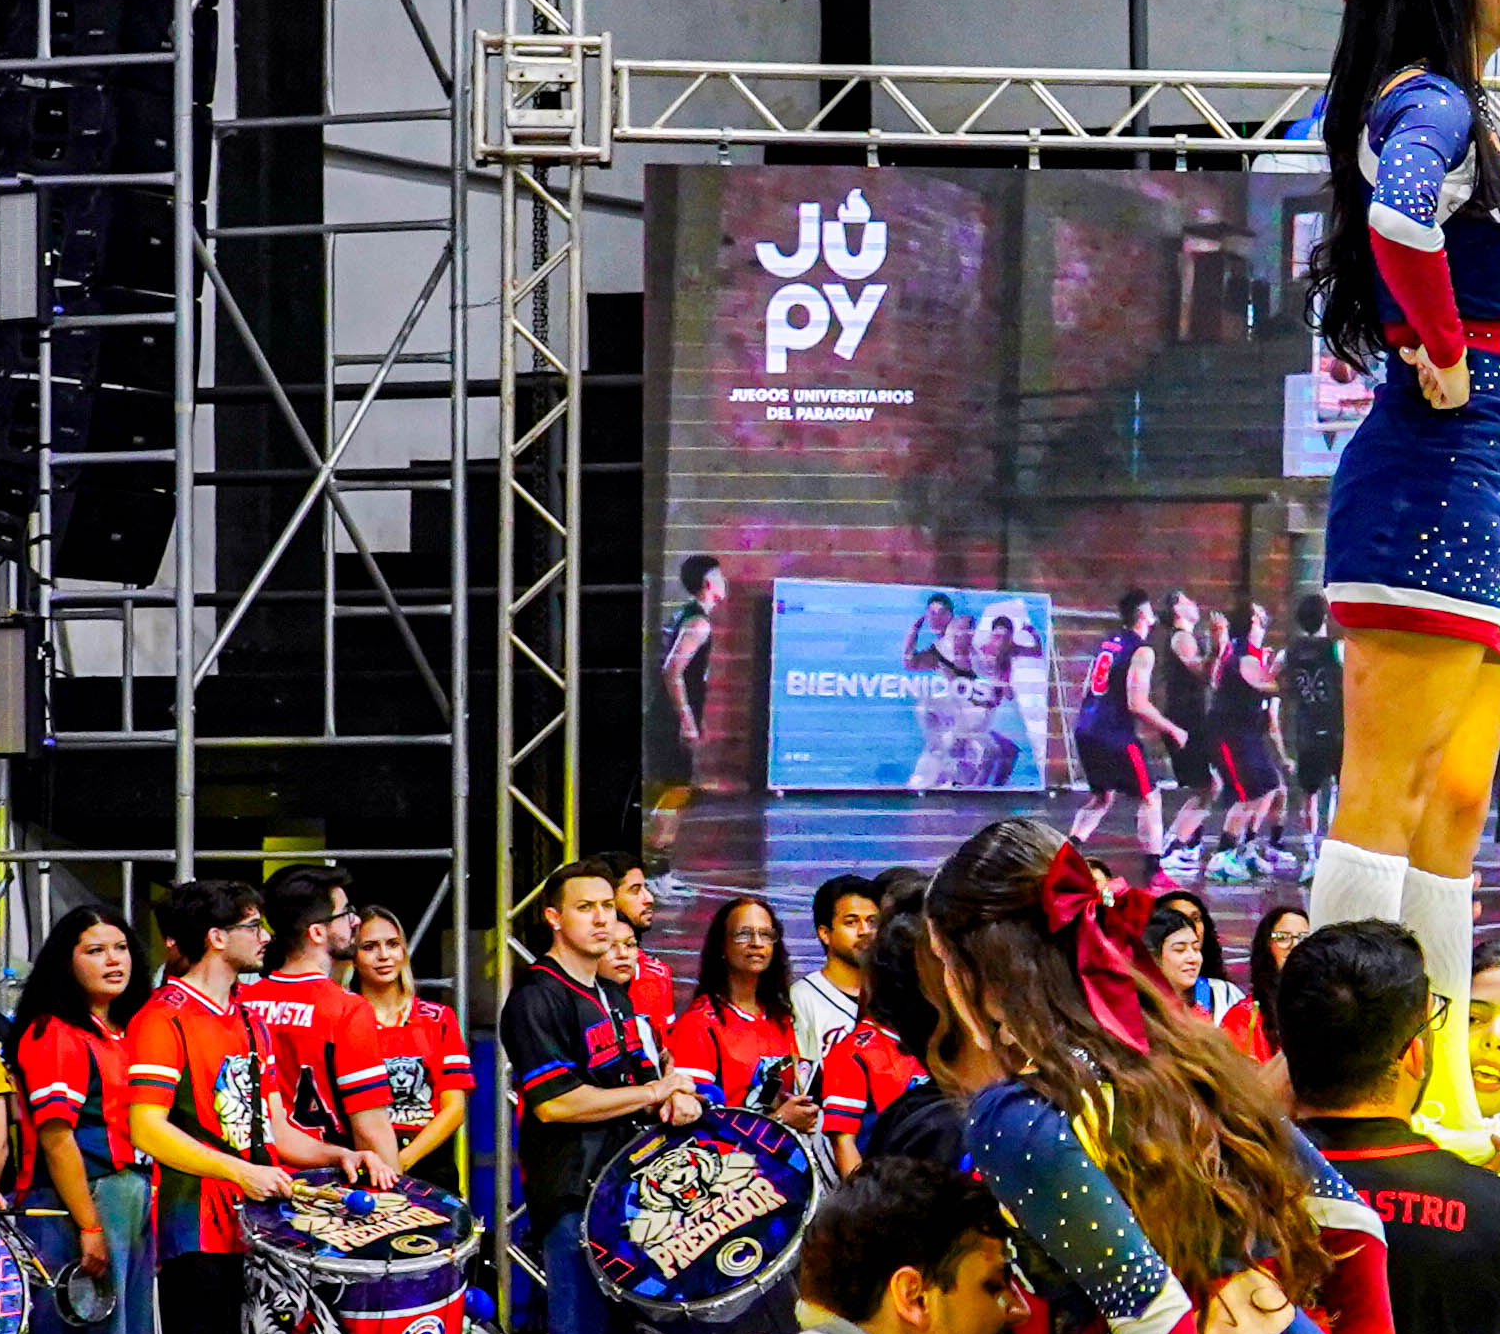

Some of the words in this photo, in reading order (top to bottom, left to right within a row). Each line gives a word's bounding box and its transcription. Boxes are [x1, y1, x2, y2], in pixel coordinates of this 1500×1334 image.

[729, 388, 790, 402] JUEGOS
[793, 389, 914, 404] UNIVERSITARIOS
[766, 406, 793, 421] DEL
[795, 406, 874, 421] PARAGUAY
[786, 670, 994, 701] BIENVENIDOS
[646, 1177, 788, 1280] PREDADOR
